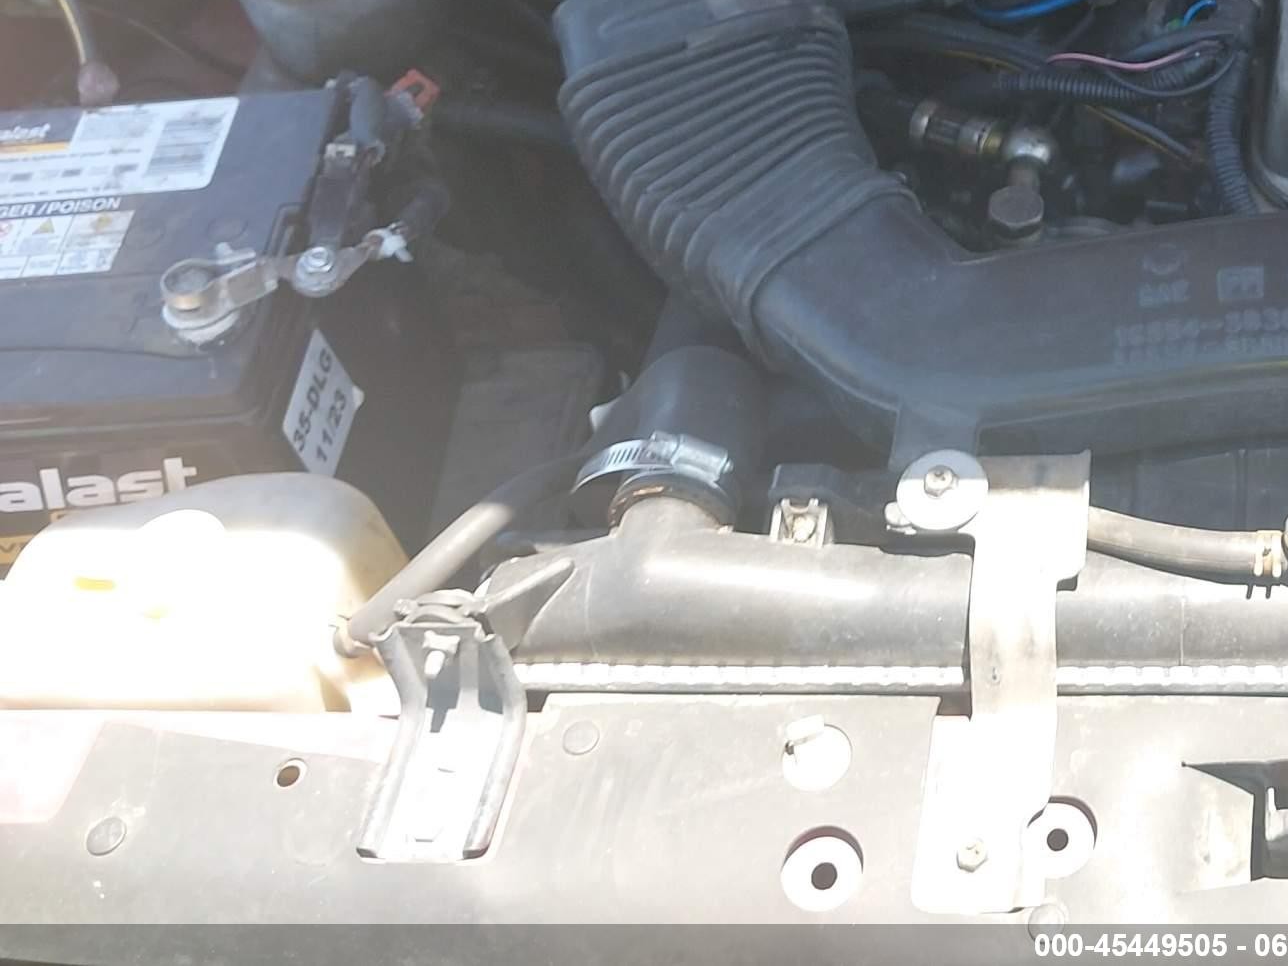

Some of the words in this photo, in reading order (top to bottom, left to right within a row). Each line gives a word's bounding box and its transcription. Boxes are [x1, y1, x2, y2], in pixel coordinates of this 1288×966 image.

[293, 347, 332, 452] 35-DLG
[315, 389, 346, 463] 11/23
[0, 457, 197, 512] alast
